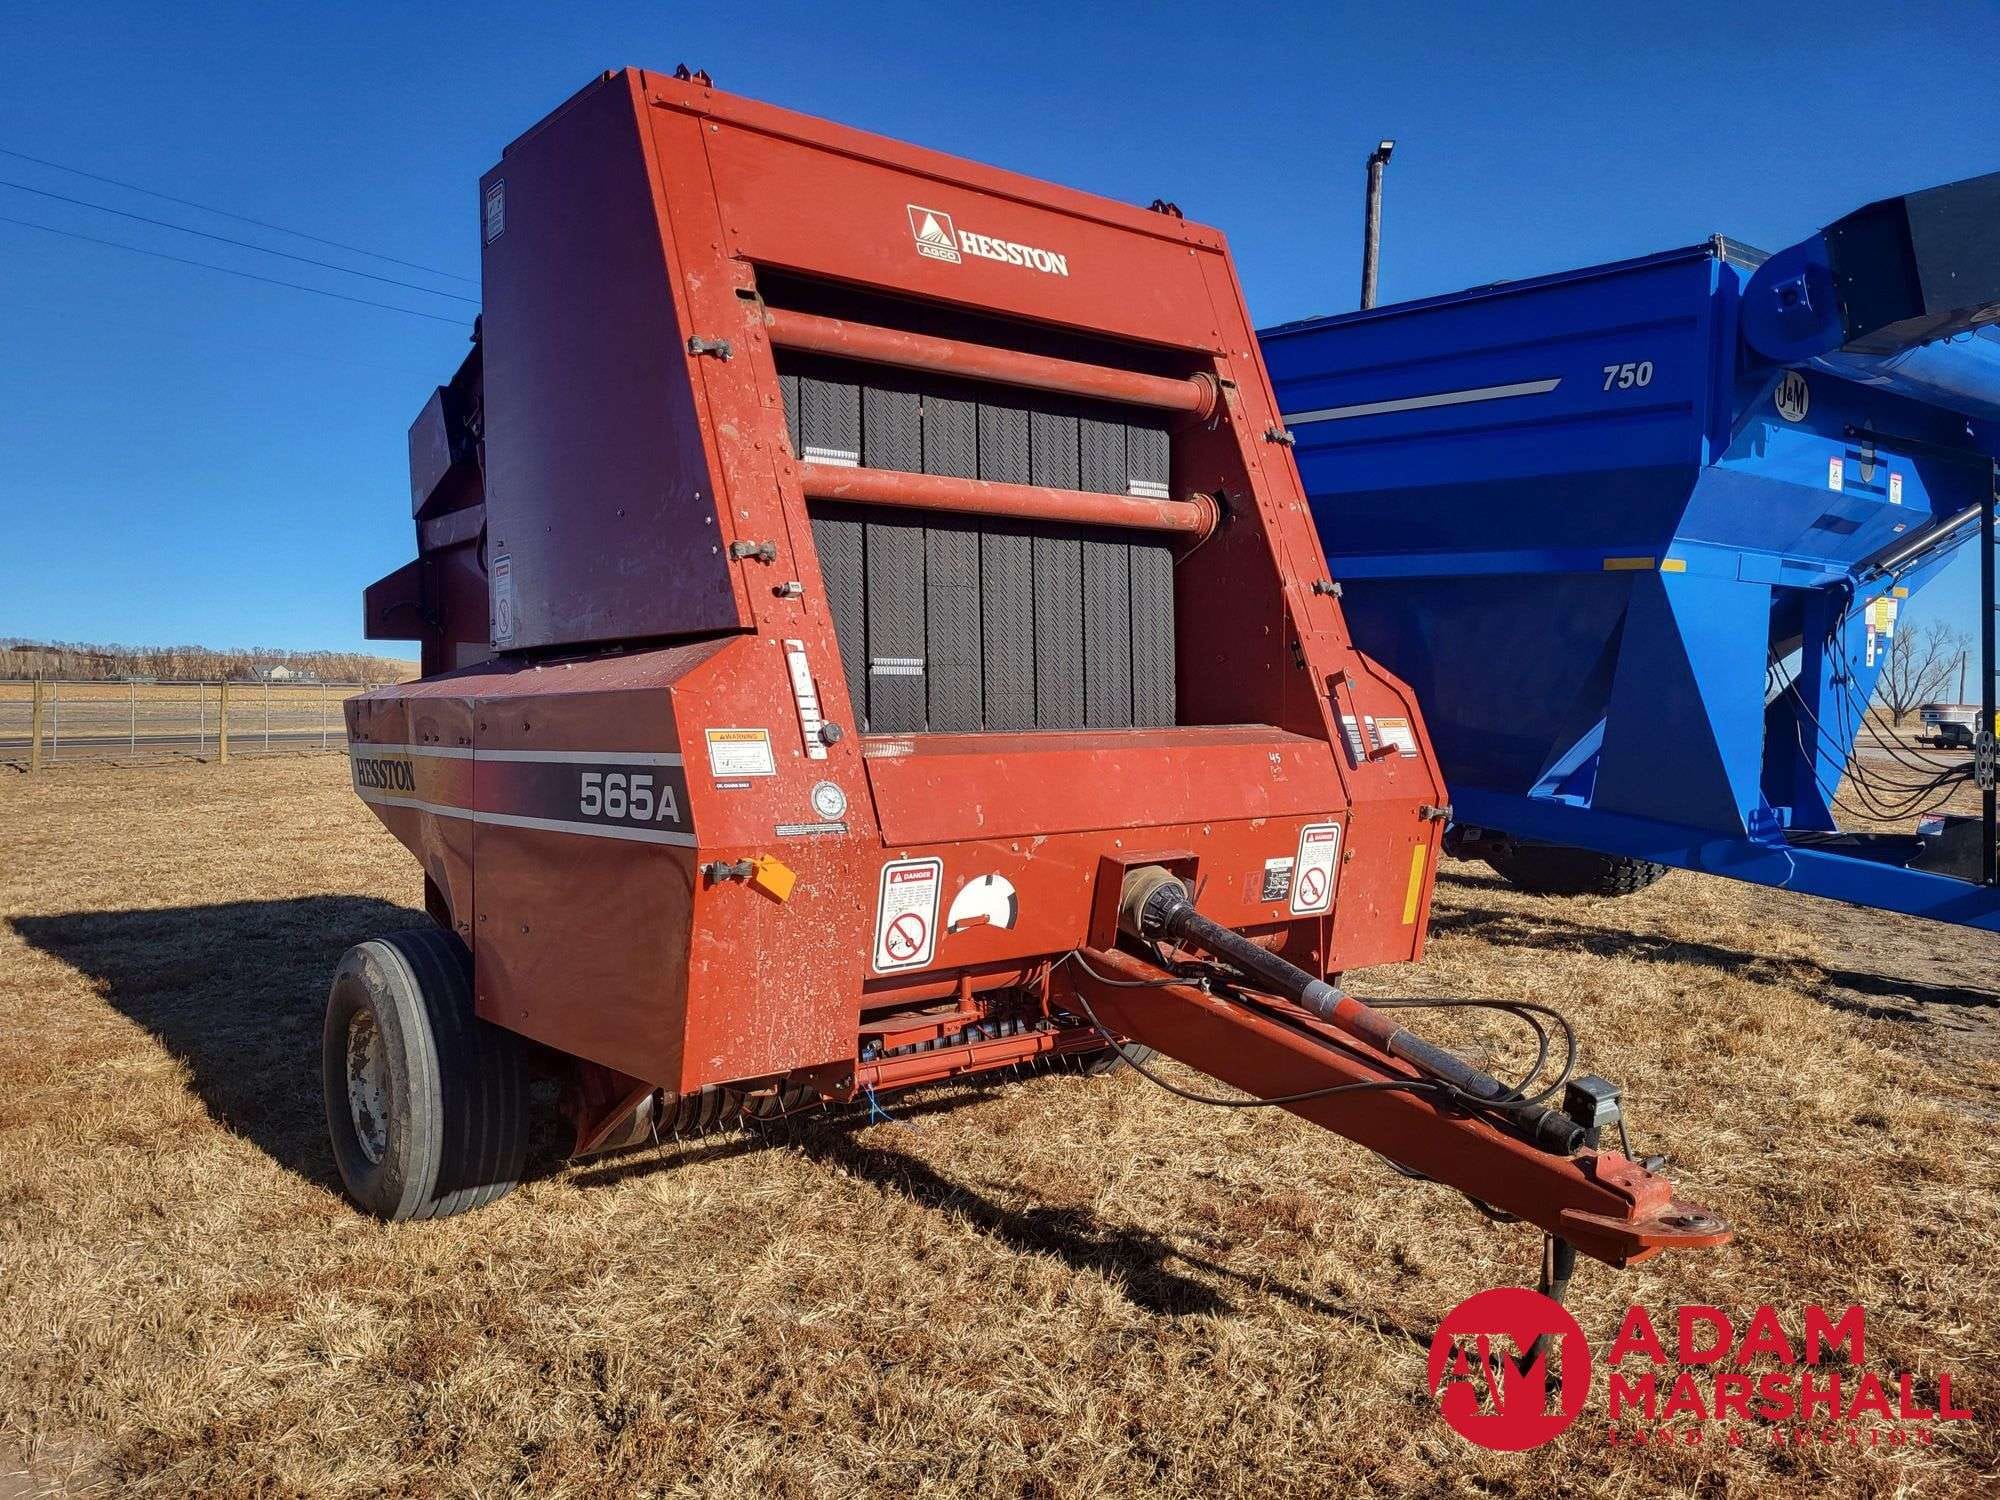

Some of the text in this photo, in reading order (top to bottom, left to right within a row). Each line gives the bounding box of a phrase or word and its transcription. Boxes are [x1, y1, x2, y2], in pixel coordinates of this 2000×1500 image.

[921, 245, 957, 260] AGCO
[957, 229, 1069, 277] HESSTON
[1602, 361, 1654, 392] 750
[1777, 376, 1806, 415] J&M
[355, 758, 416, 792] HESSTON
[580, 772, 681, 823] 565A
[903, 870, 931, 880] DANGER
